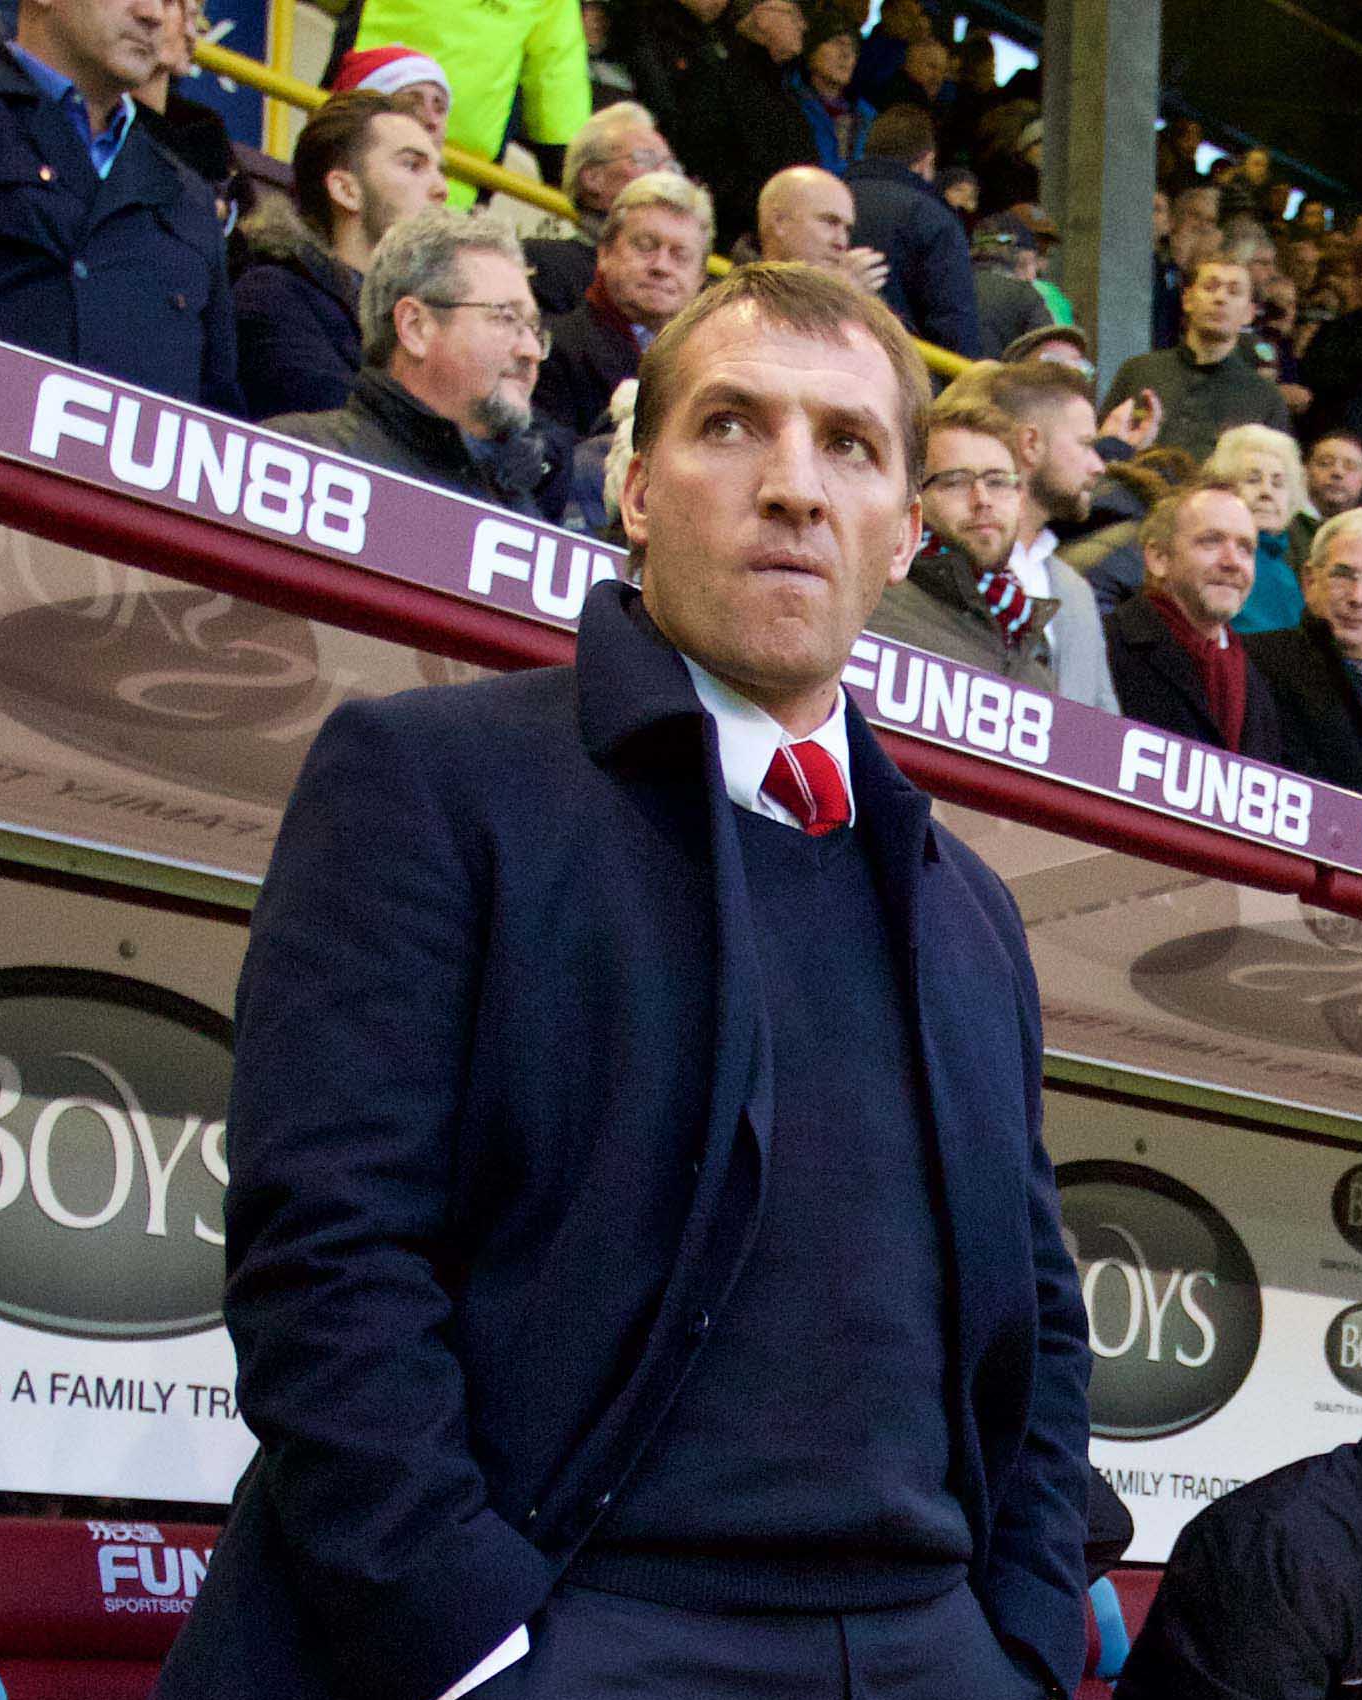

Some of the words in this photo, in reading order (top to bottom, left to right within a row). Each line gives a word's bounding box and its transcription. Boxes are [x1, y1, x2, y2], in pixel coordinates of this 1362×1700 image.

[29, 374, 371, 554] FUN88
[1118, 728, 1313, 846] FUN88
[1063, 1222, 1218, 1368] OYS
[12, 1370, 36, 1403] A
[50, 1372, 177, 1415] FAMILY
[97, 1544, 214, 1598] FUN
[104, 1597, 193, 1614] SPORTSBO
